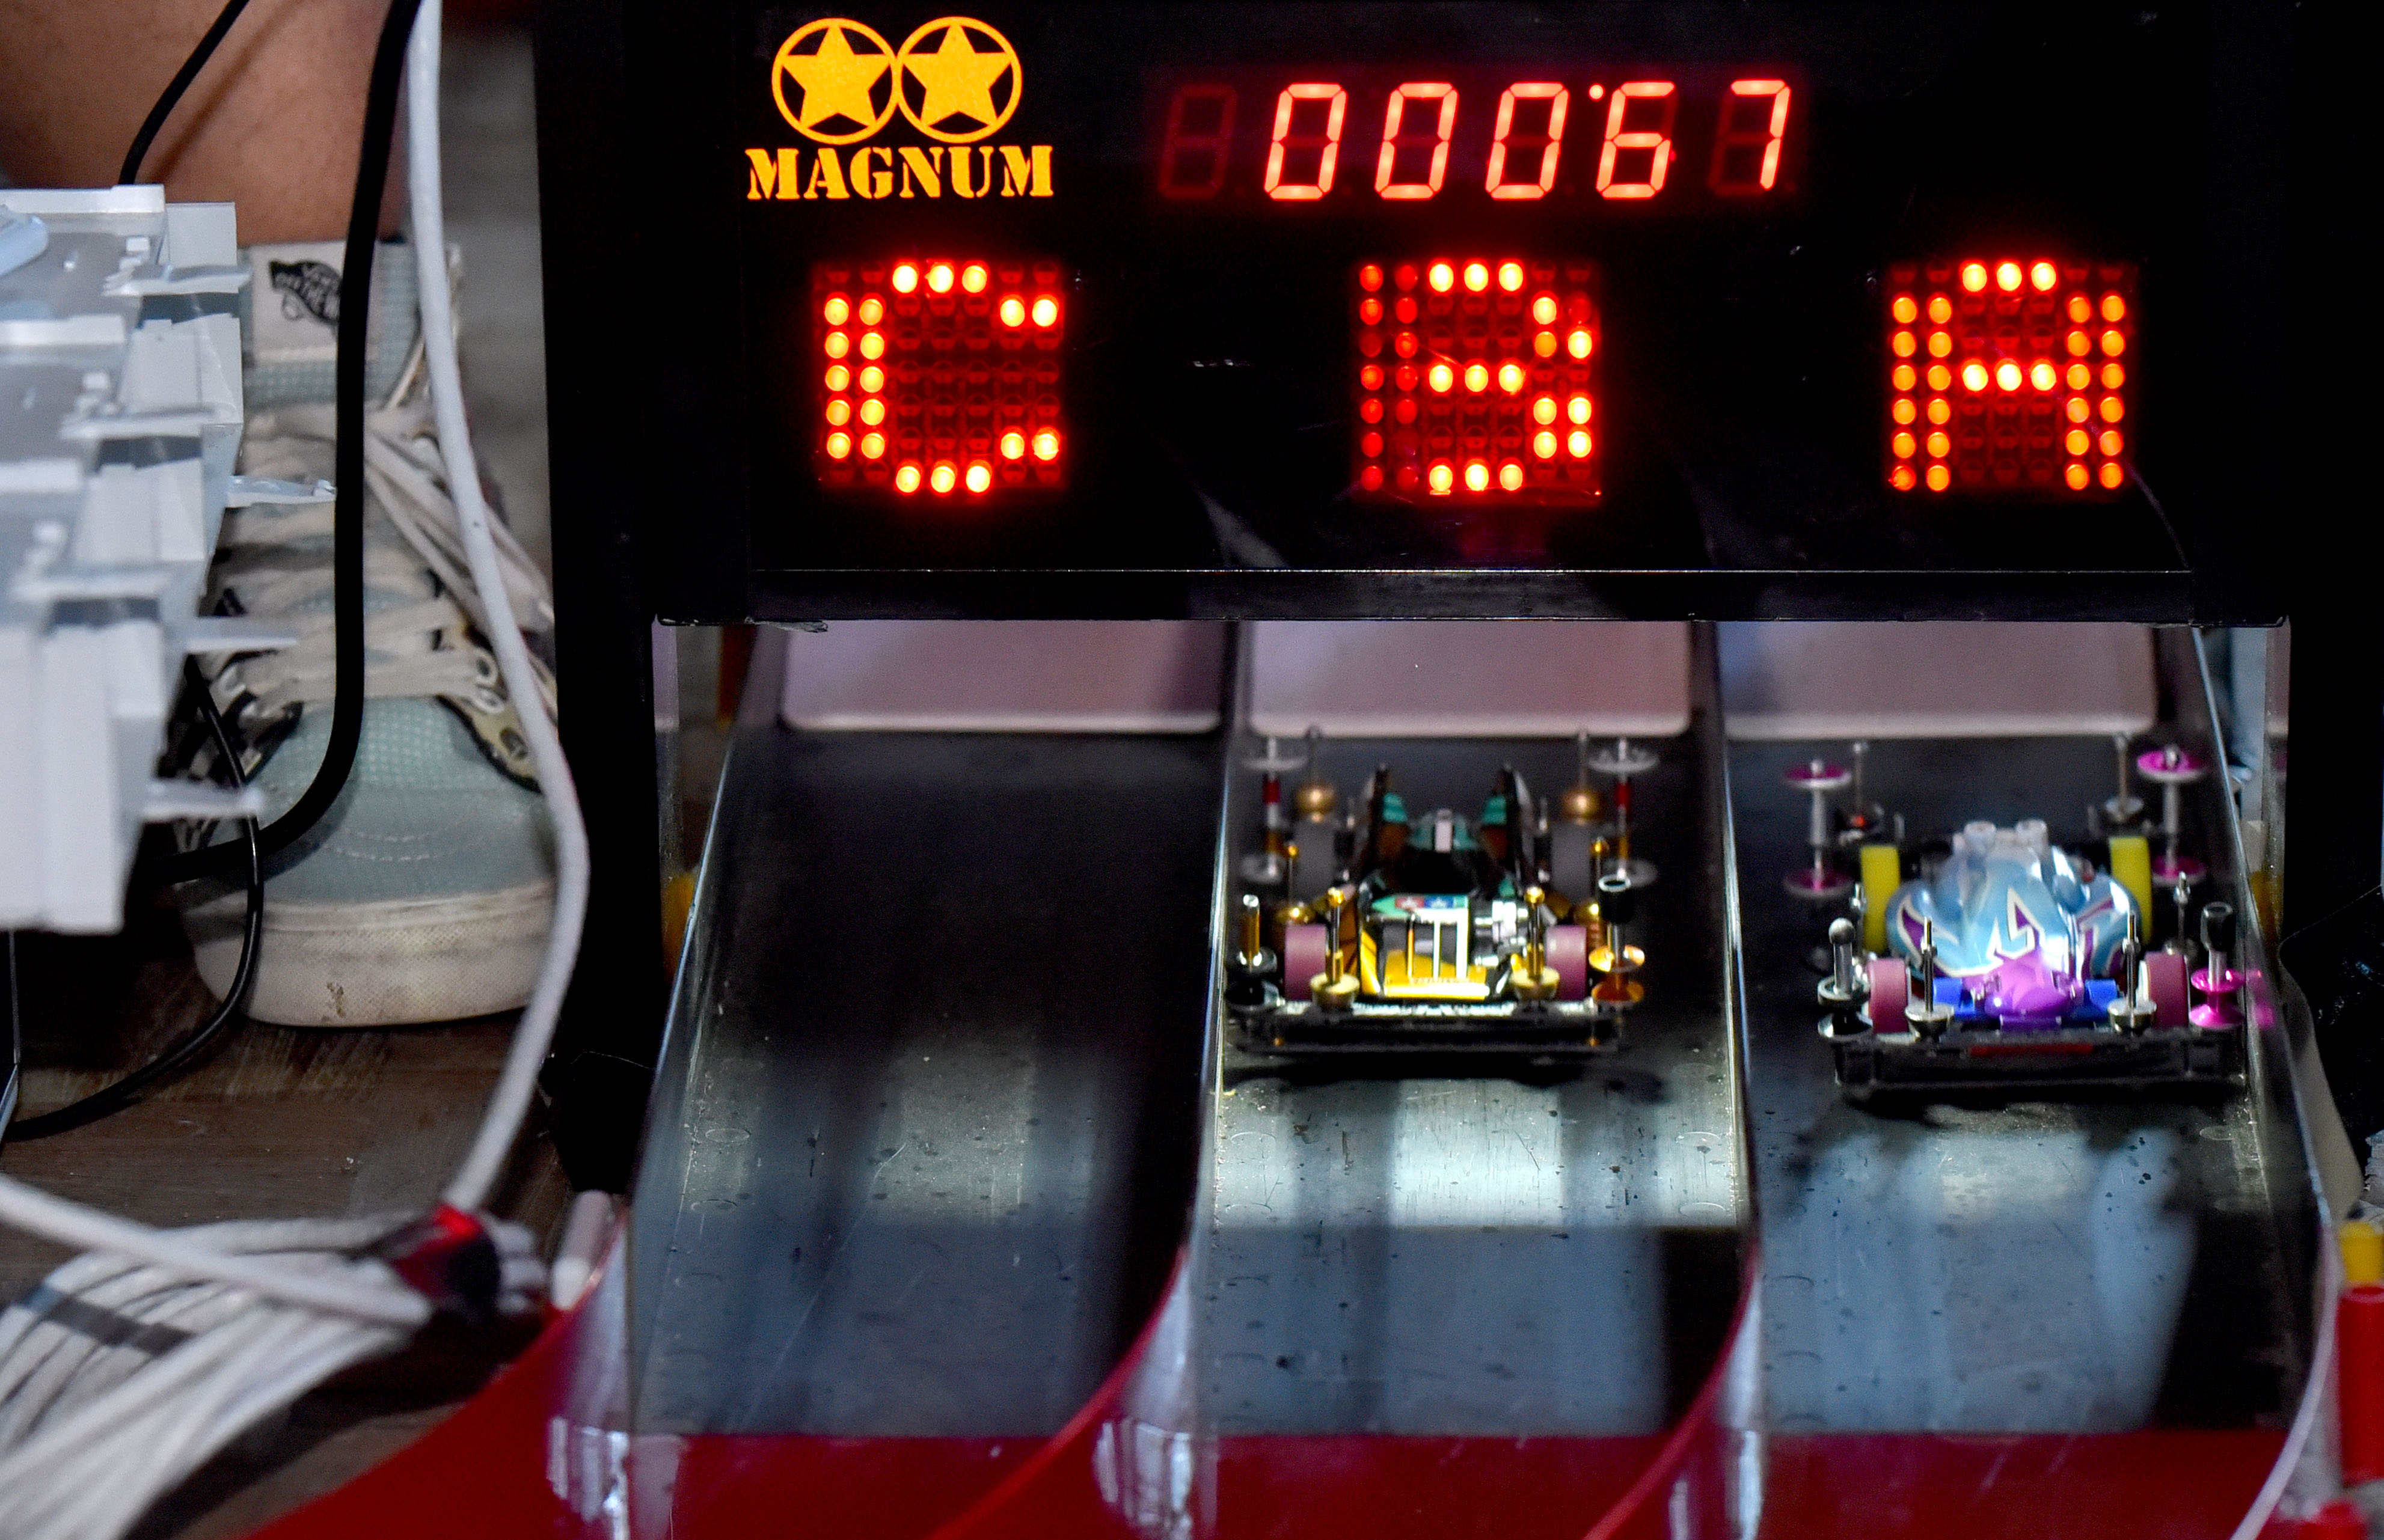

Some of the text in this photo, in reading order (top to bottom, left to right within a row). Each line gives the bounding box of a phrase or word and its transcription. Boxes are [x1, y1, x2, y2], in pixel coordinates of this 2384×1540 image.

[745, 145, 1054, 200] MAGNUM
[824, 263, 1060, 493] C
[1359, 262, 1593, 492] B
[1892, 261, 2125, 492] A
